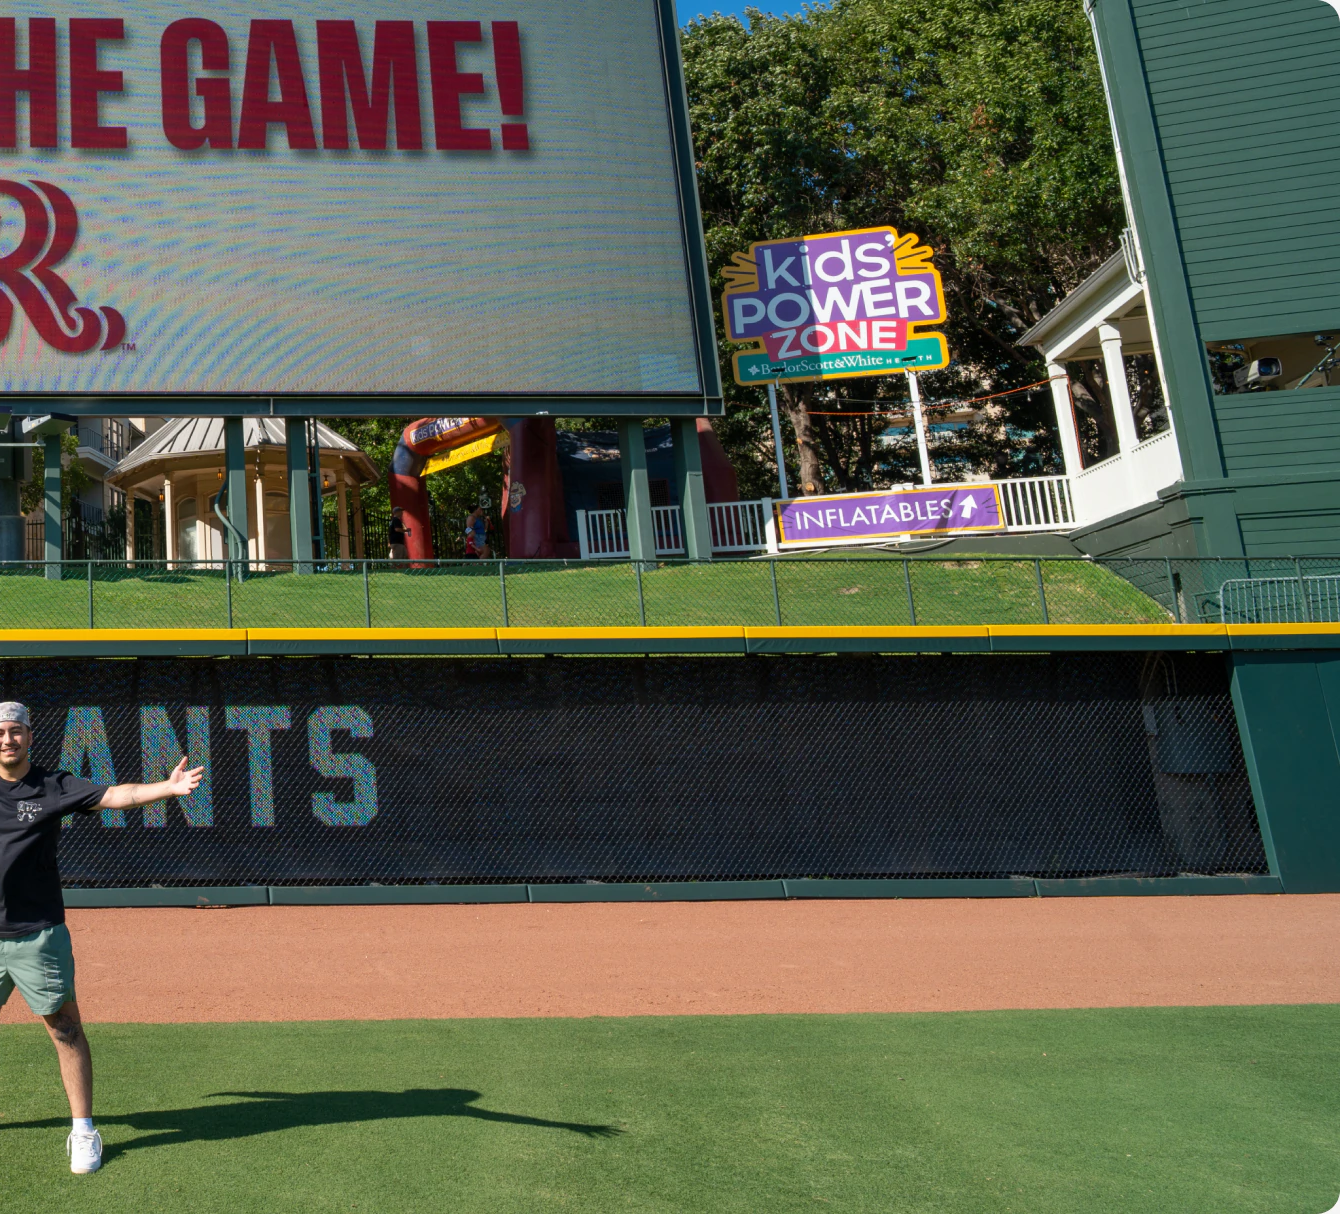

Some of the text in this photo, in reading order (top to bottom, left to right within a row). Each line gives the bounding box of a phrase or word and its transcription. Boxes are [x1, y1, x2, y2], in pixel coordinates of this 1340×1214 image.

[160, 17, 530, 151] GAME!
[733, 278, 935, 334] POWER
[771, 320, 897, 360] ZONE
[886, 354, 933, 364] HETH
[795, 498, 953, 530] INFLATABLES
